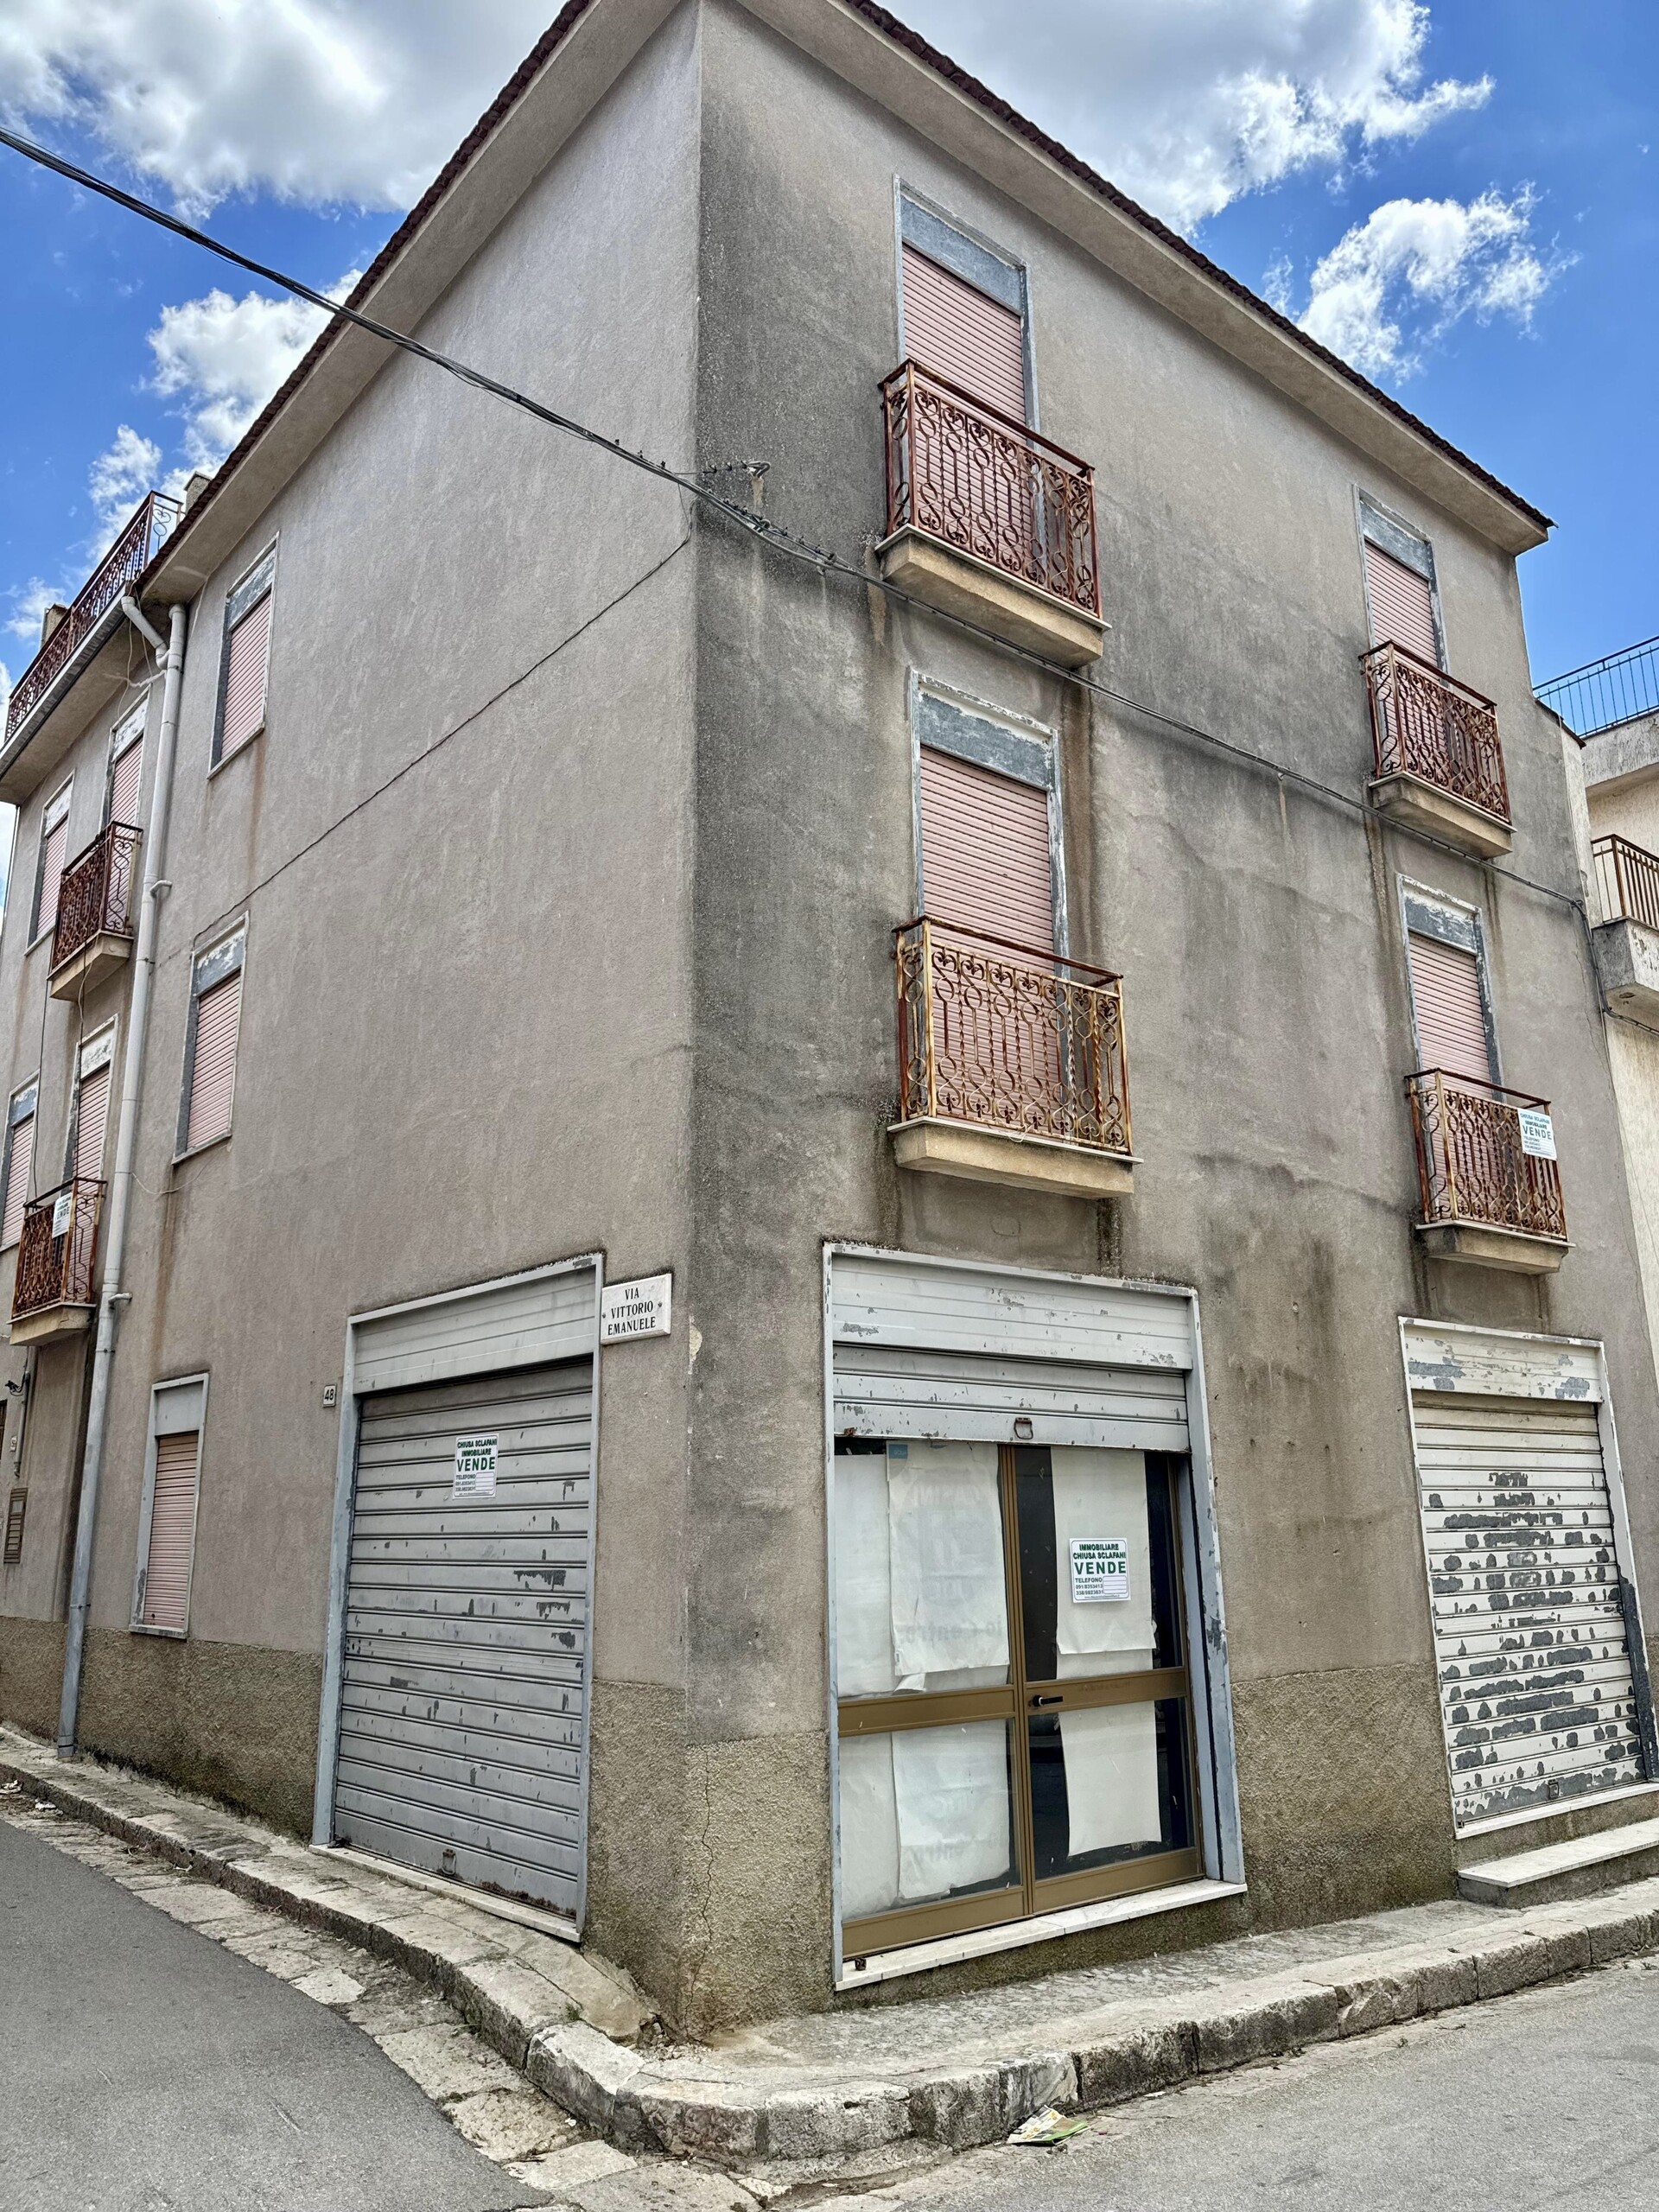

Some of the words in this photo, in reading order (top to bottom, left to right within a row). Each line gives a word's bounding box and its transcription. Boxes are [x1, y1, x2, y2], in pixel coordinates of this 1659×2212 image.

[1522, 1125, 1552, 1140] VENDE
[625, 1287, 639, 1300] VIA
[611, 1300, 653, 1319] VITTORIO
[607, 1316, 657, 1336] EMANUELE
[324, 1388, 334, 1401] 48
[461, 1448, 492, 1457] IMMOBILIARE
[457, 1457, 495, 1471] VENDE
[1074, 1561, 1127, 1575] VENDE
